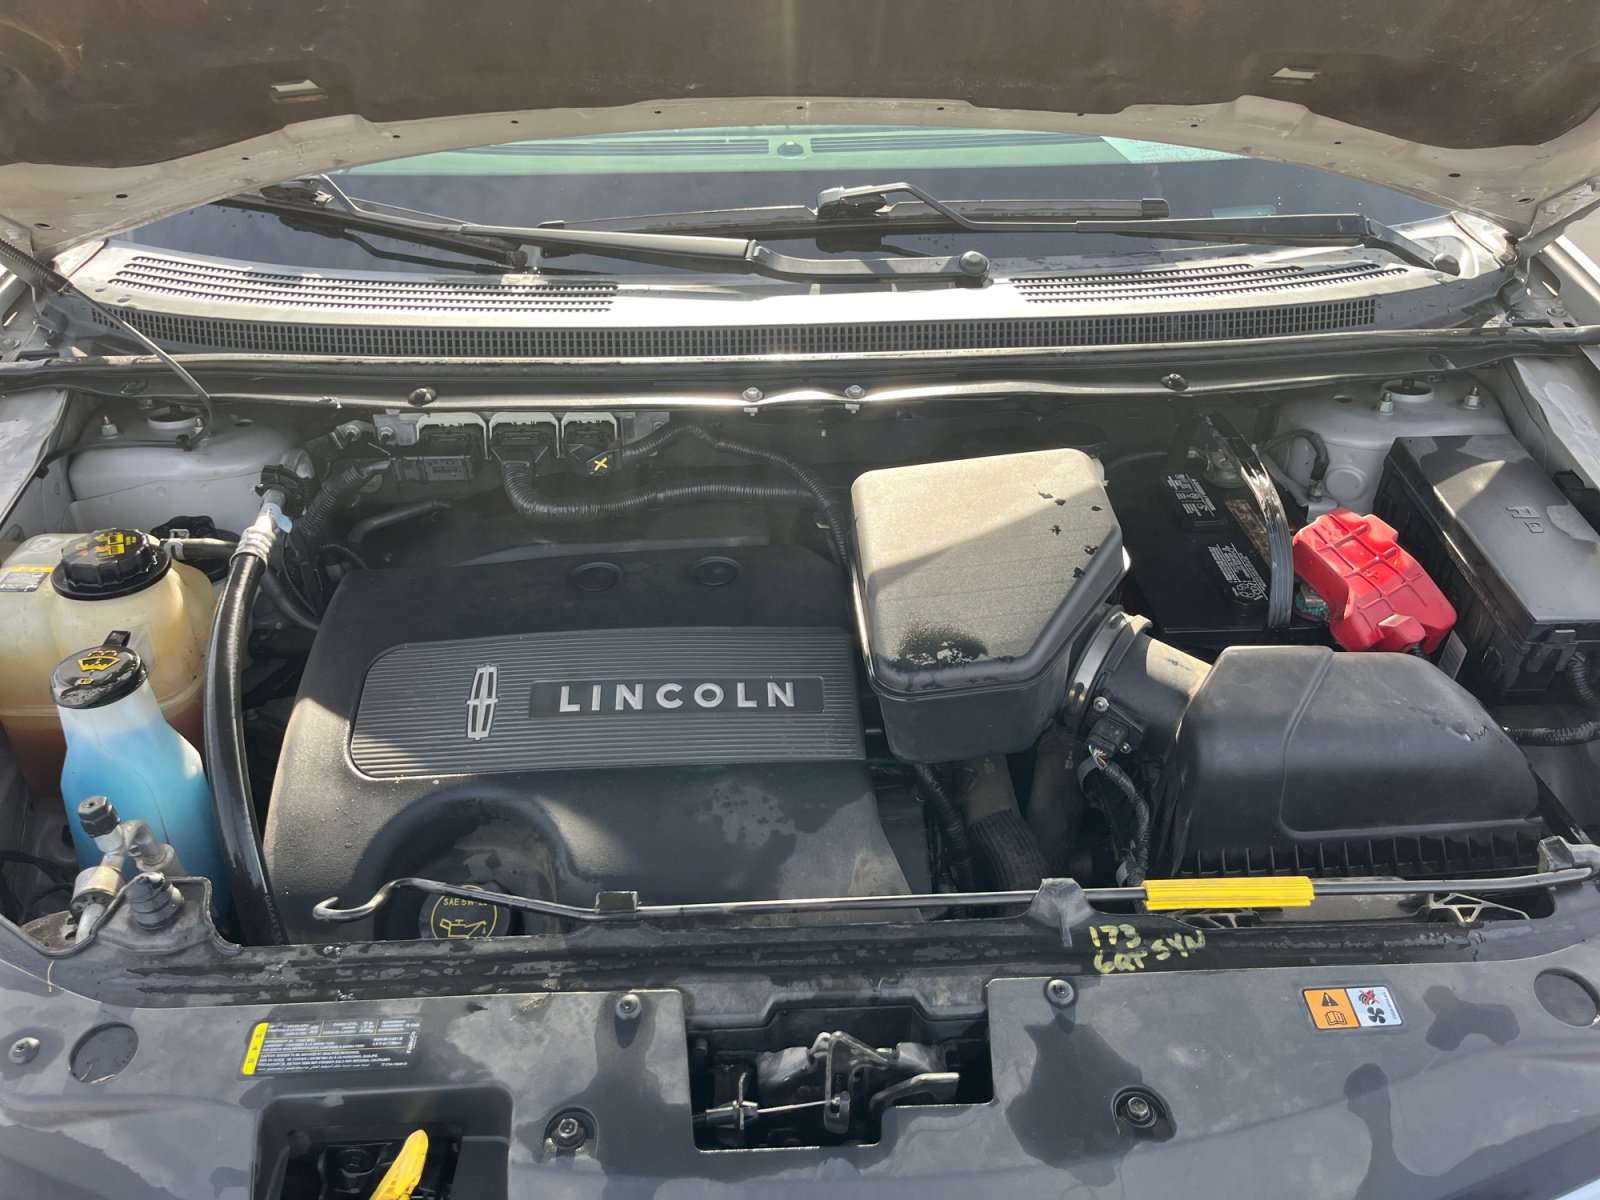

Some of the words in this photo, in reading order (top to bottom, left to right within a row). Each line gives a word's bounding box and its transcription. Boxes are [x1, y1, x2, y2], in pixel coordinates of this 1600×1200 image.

[559, 682, 795, 712] LINCOLN
[443, 898, 460, 906] SAE
[1089, 924, 1141, 948] 173
[1094, 949, 1148, 974] 6QT
[1151, 930, 1206, 961] SYN
